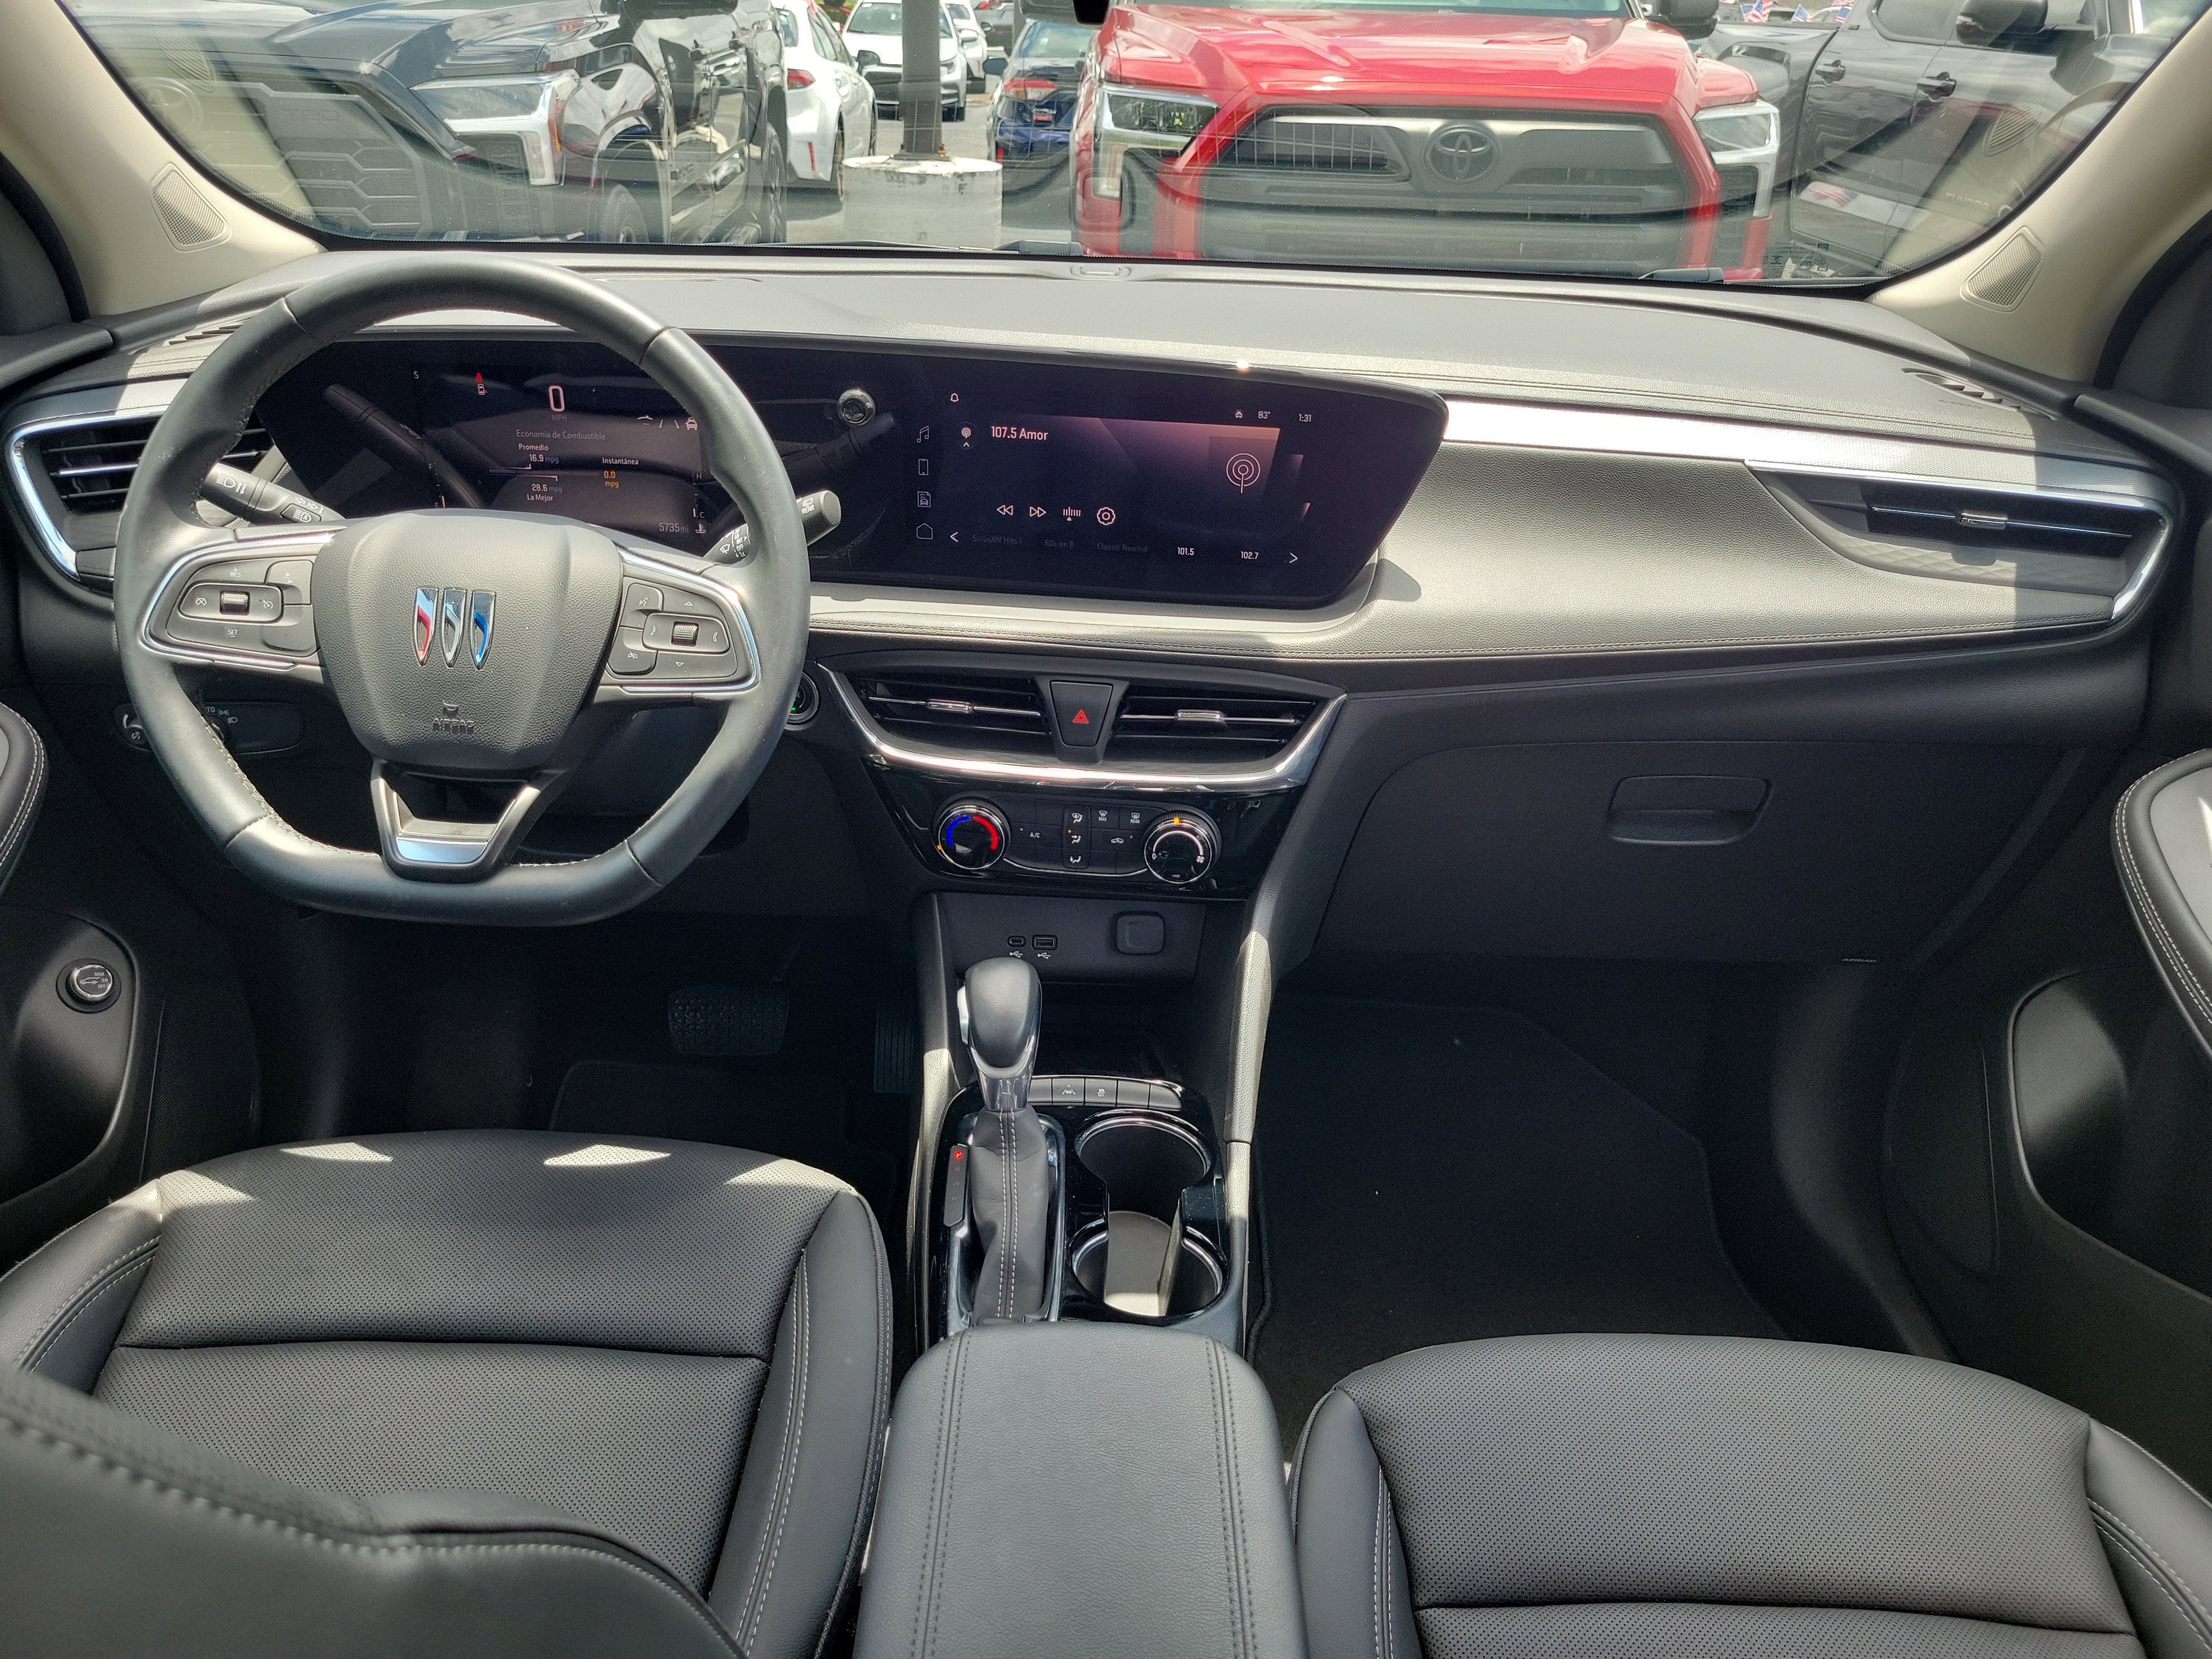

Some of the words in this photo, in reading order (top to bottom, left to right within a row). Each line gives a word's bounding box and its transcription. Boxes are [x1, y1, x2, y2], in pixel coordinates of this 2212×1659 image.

[549, 385, 566, 412] 0
[1298, 413, 1312, 422] 1:31
[516, 429, 551, 438] Economía
[552, 431, 561, 439] de
[562, 431, 606, 441] Combustible
[991, 426, 1017, 438] 107.5
[1019, 428, 1048, 441] Amor
[529, 454, 544, 462] 16.9
[602, 457, 639, 465] Instantánea
[603, 471, 616, 479] 0.0
[531, 484, 548, 492] 28.6
[549, 486, 563, 494] mpg
[605, 481, 619, 489] mpg
[535, 494, 554, 503] Mejor
[801, 504, 816, 516] REAR
[659, 522, 680, 533] 5735
[736, 544, 744, 552] OFF
[1177, 547, 1195, 556] 101.5
[1240, 550, 1259, 560] 102.7
